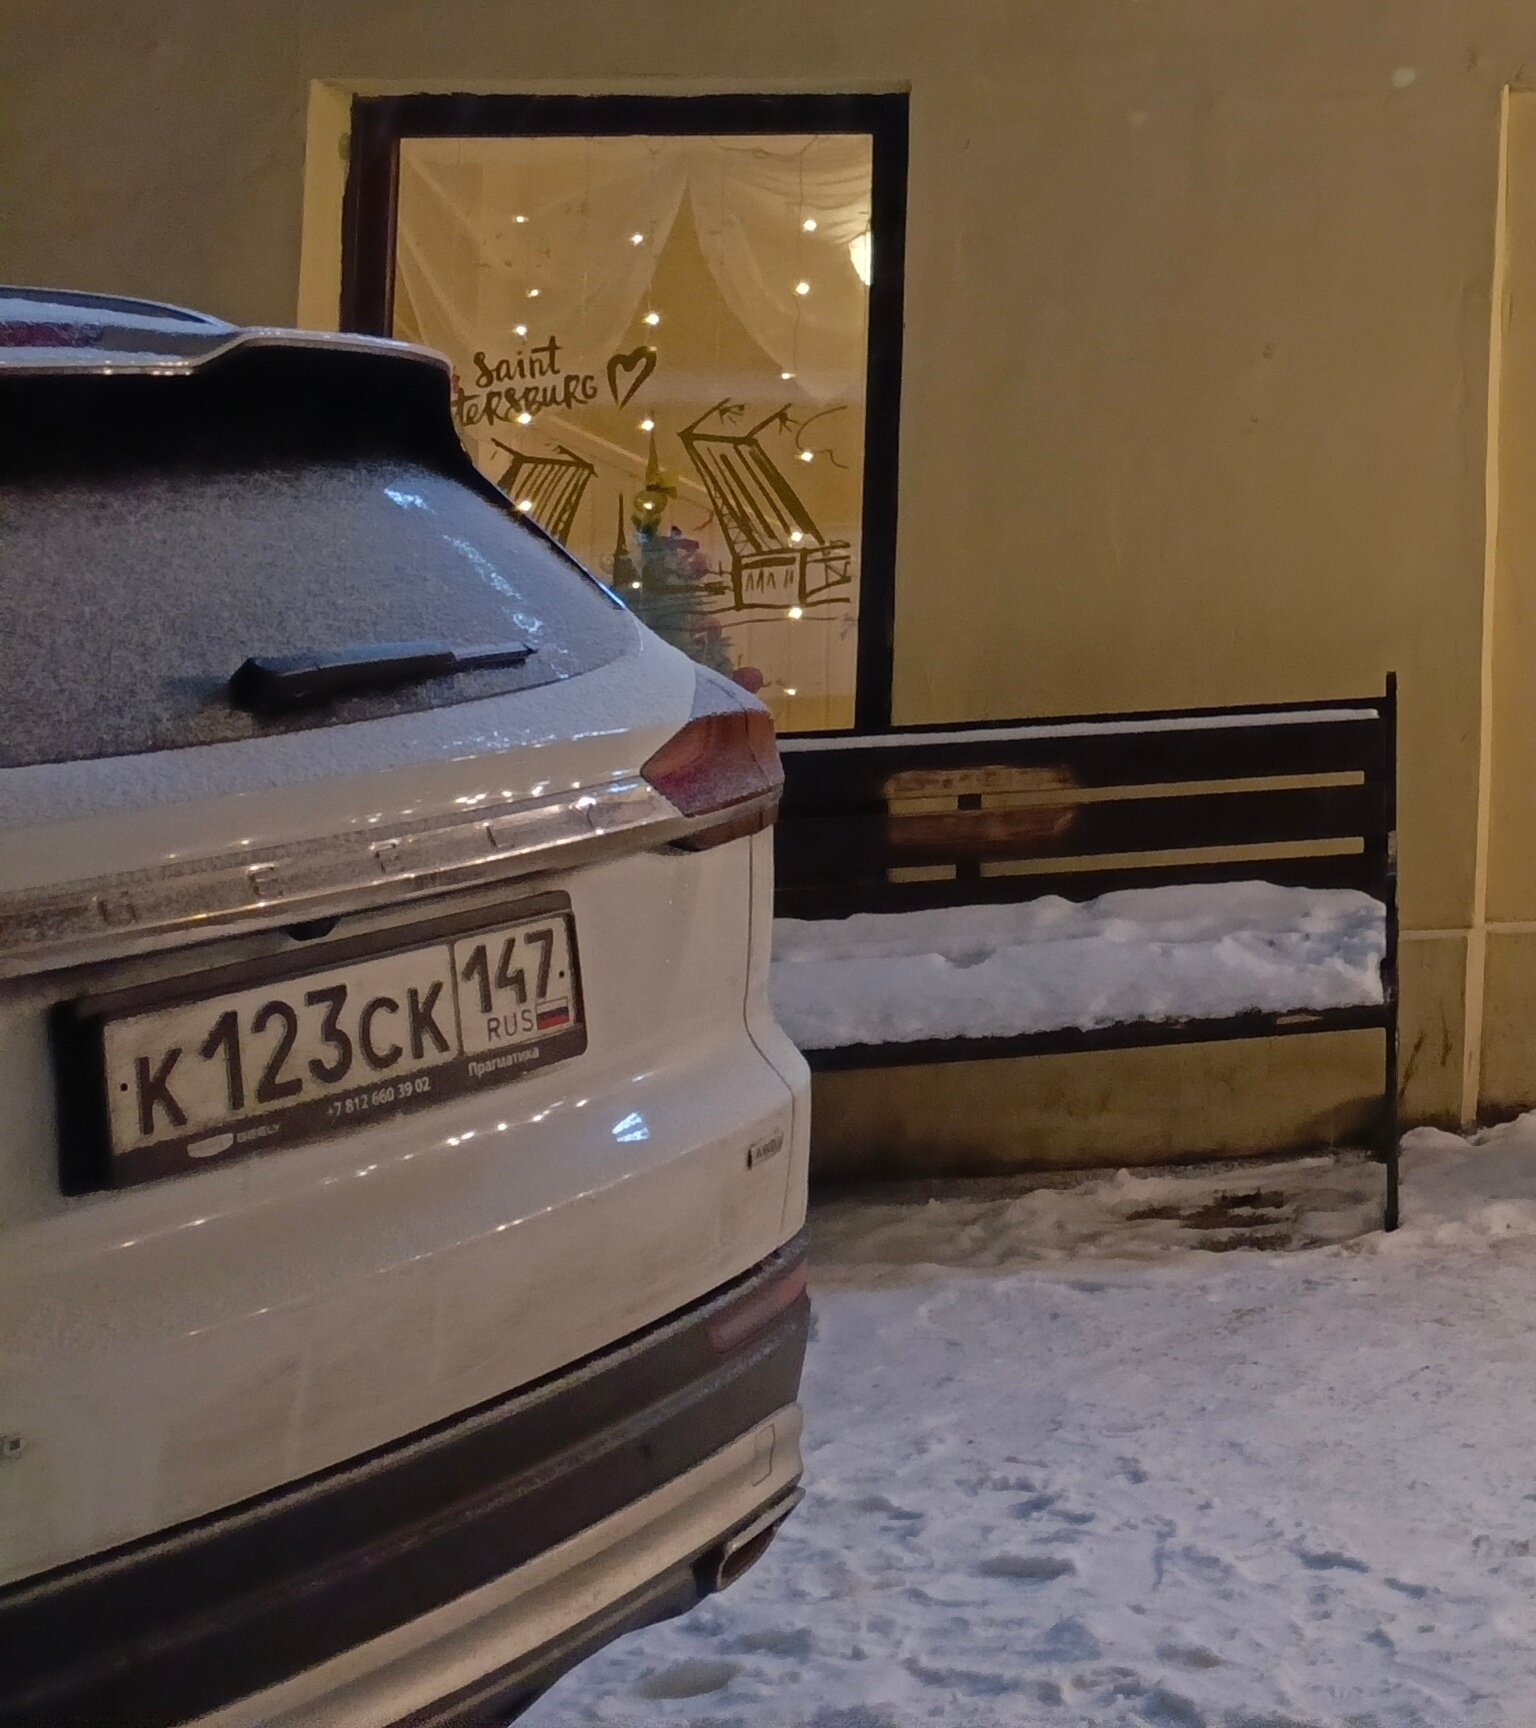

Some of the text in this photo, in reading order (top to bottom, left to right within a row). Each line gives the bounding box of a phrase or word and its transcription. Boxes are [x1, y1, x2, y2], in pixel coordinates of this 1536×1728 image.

[473, 335, 562, 388] Saint
[461, 928, 554, 1013] 147
[487, 1009, 535, 1042] RUS
[345, 1094, 369, 1114] 812
[371, 1087, 395, 1106] 660
[397, 1081, 413, 1099] 39
[414, 1076, 431, 1093] 02
